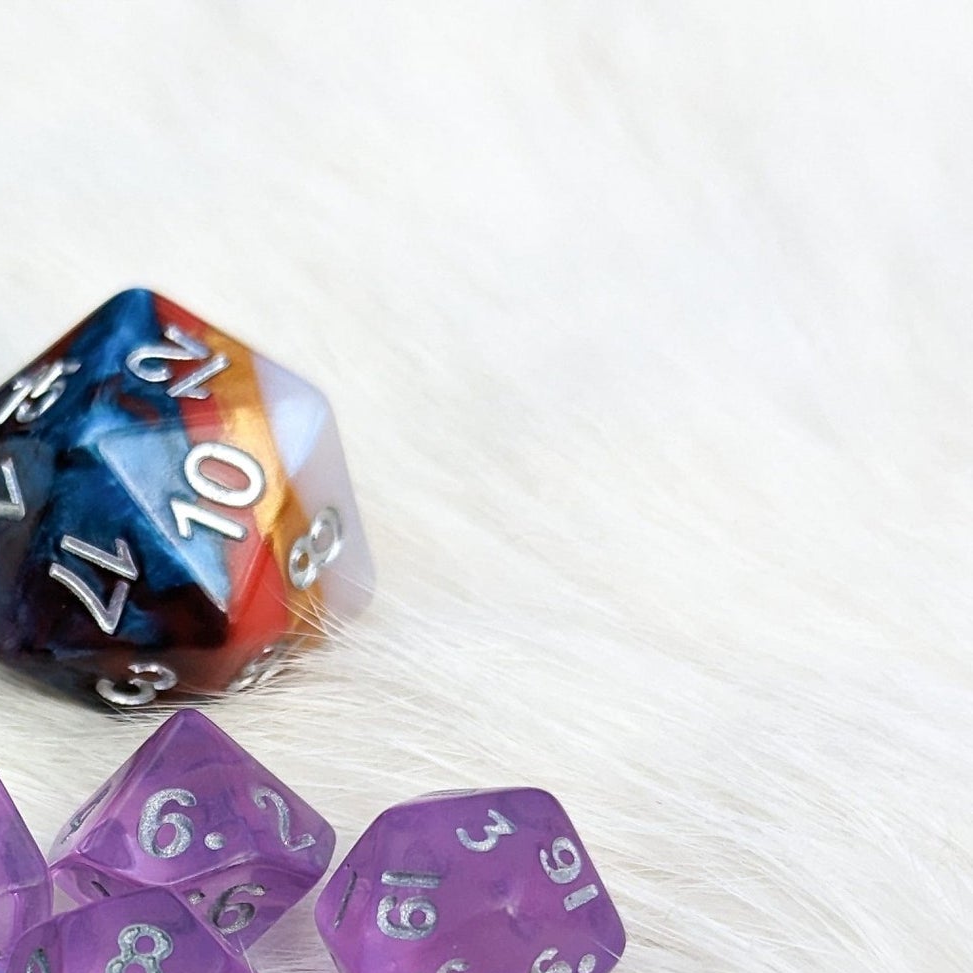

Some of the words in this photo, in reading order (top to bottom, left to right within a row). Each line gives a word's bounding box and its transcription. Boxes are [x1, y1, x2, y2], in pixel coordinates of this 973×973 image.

[126, 324, 231, 400] 12
[170, 441, 266, 540] 10
[49, 535, 139, 636] 17
[288, 506, 342, 590] 8
[95, 662, 178, 706] 3
[253, 784, 316, 851] 2
[455, 809, 517, 852] 3
[377, 870, 442, 940] 19
[540, 837, 599, 912] 16
